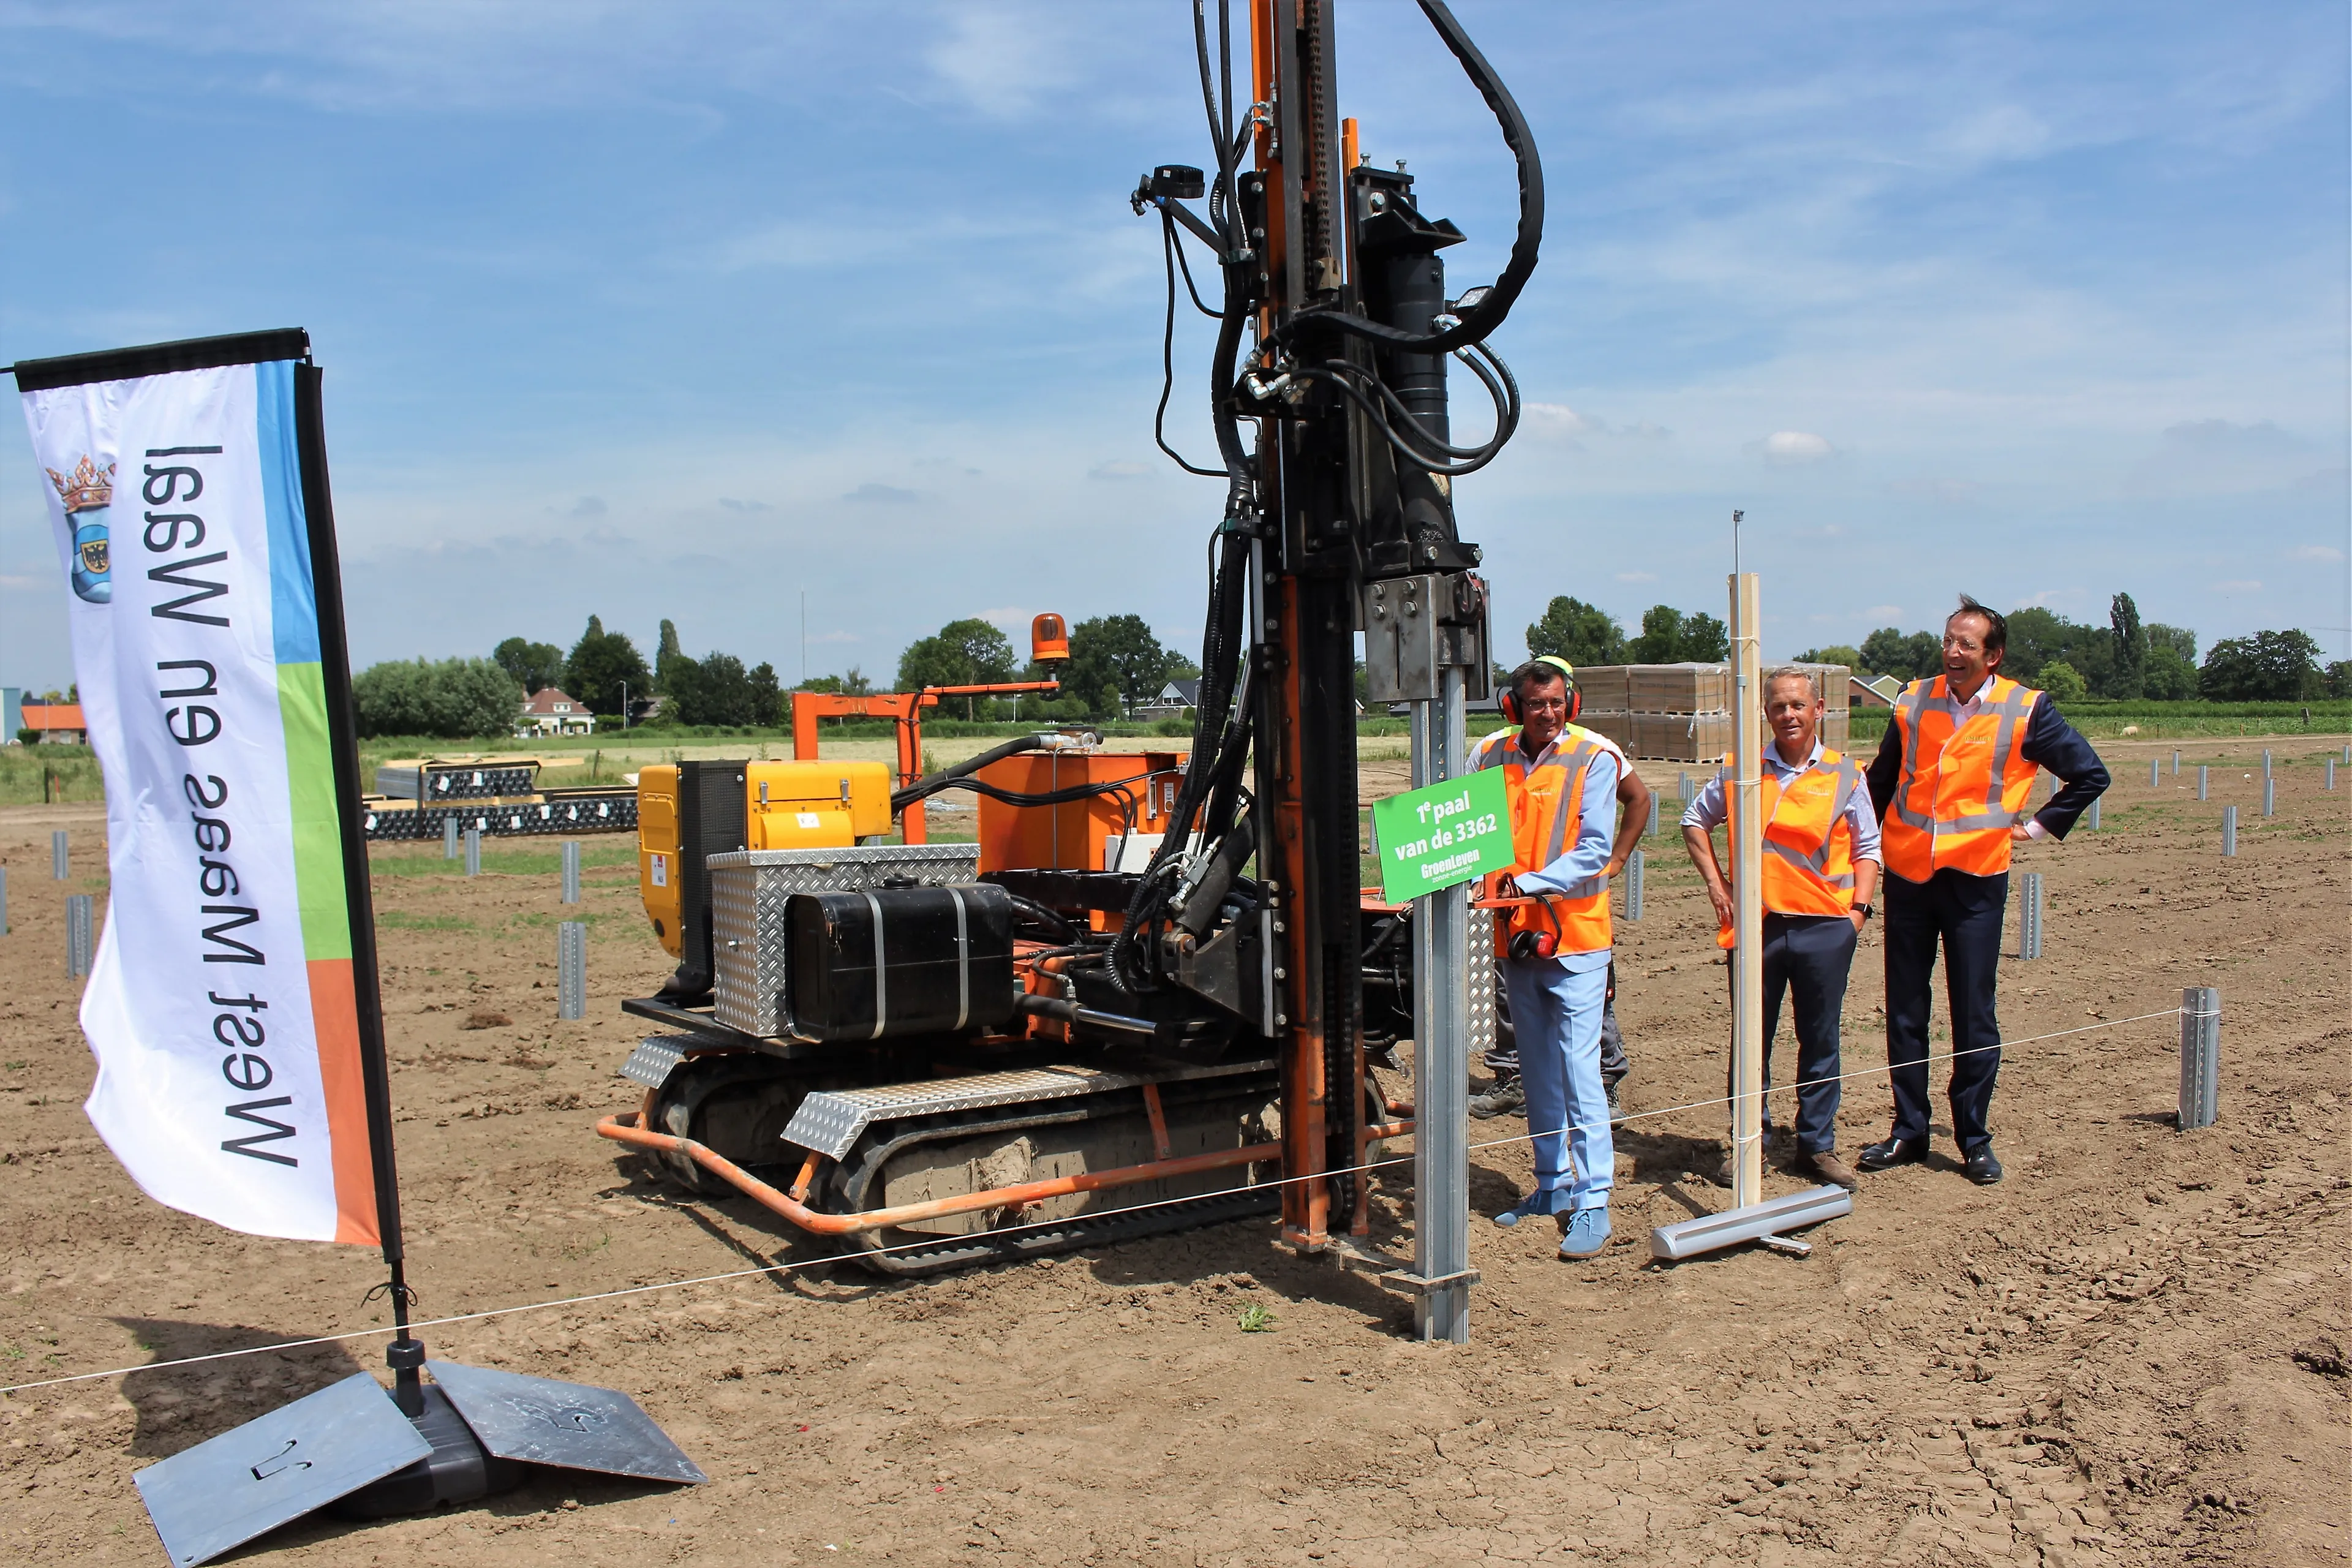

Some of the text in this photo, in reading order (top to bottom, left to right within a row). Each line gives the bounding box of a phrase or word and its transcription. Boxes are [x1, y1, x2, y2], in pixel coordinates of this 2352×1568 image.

[1433, 790, 1471, 824] paal
[1394, 813, 1498, 861] van de 3362
[1420, 848, 1480, 879] GroenLeven
[1431, 864, 1473, 884] zonne-energie
